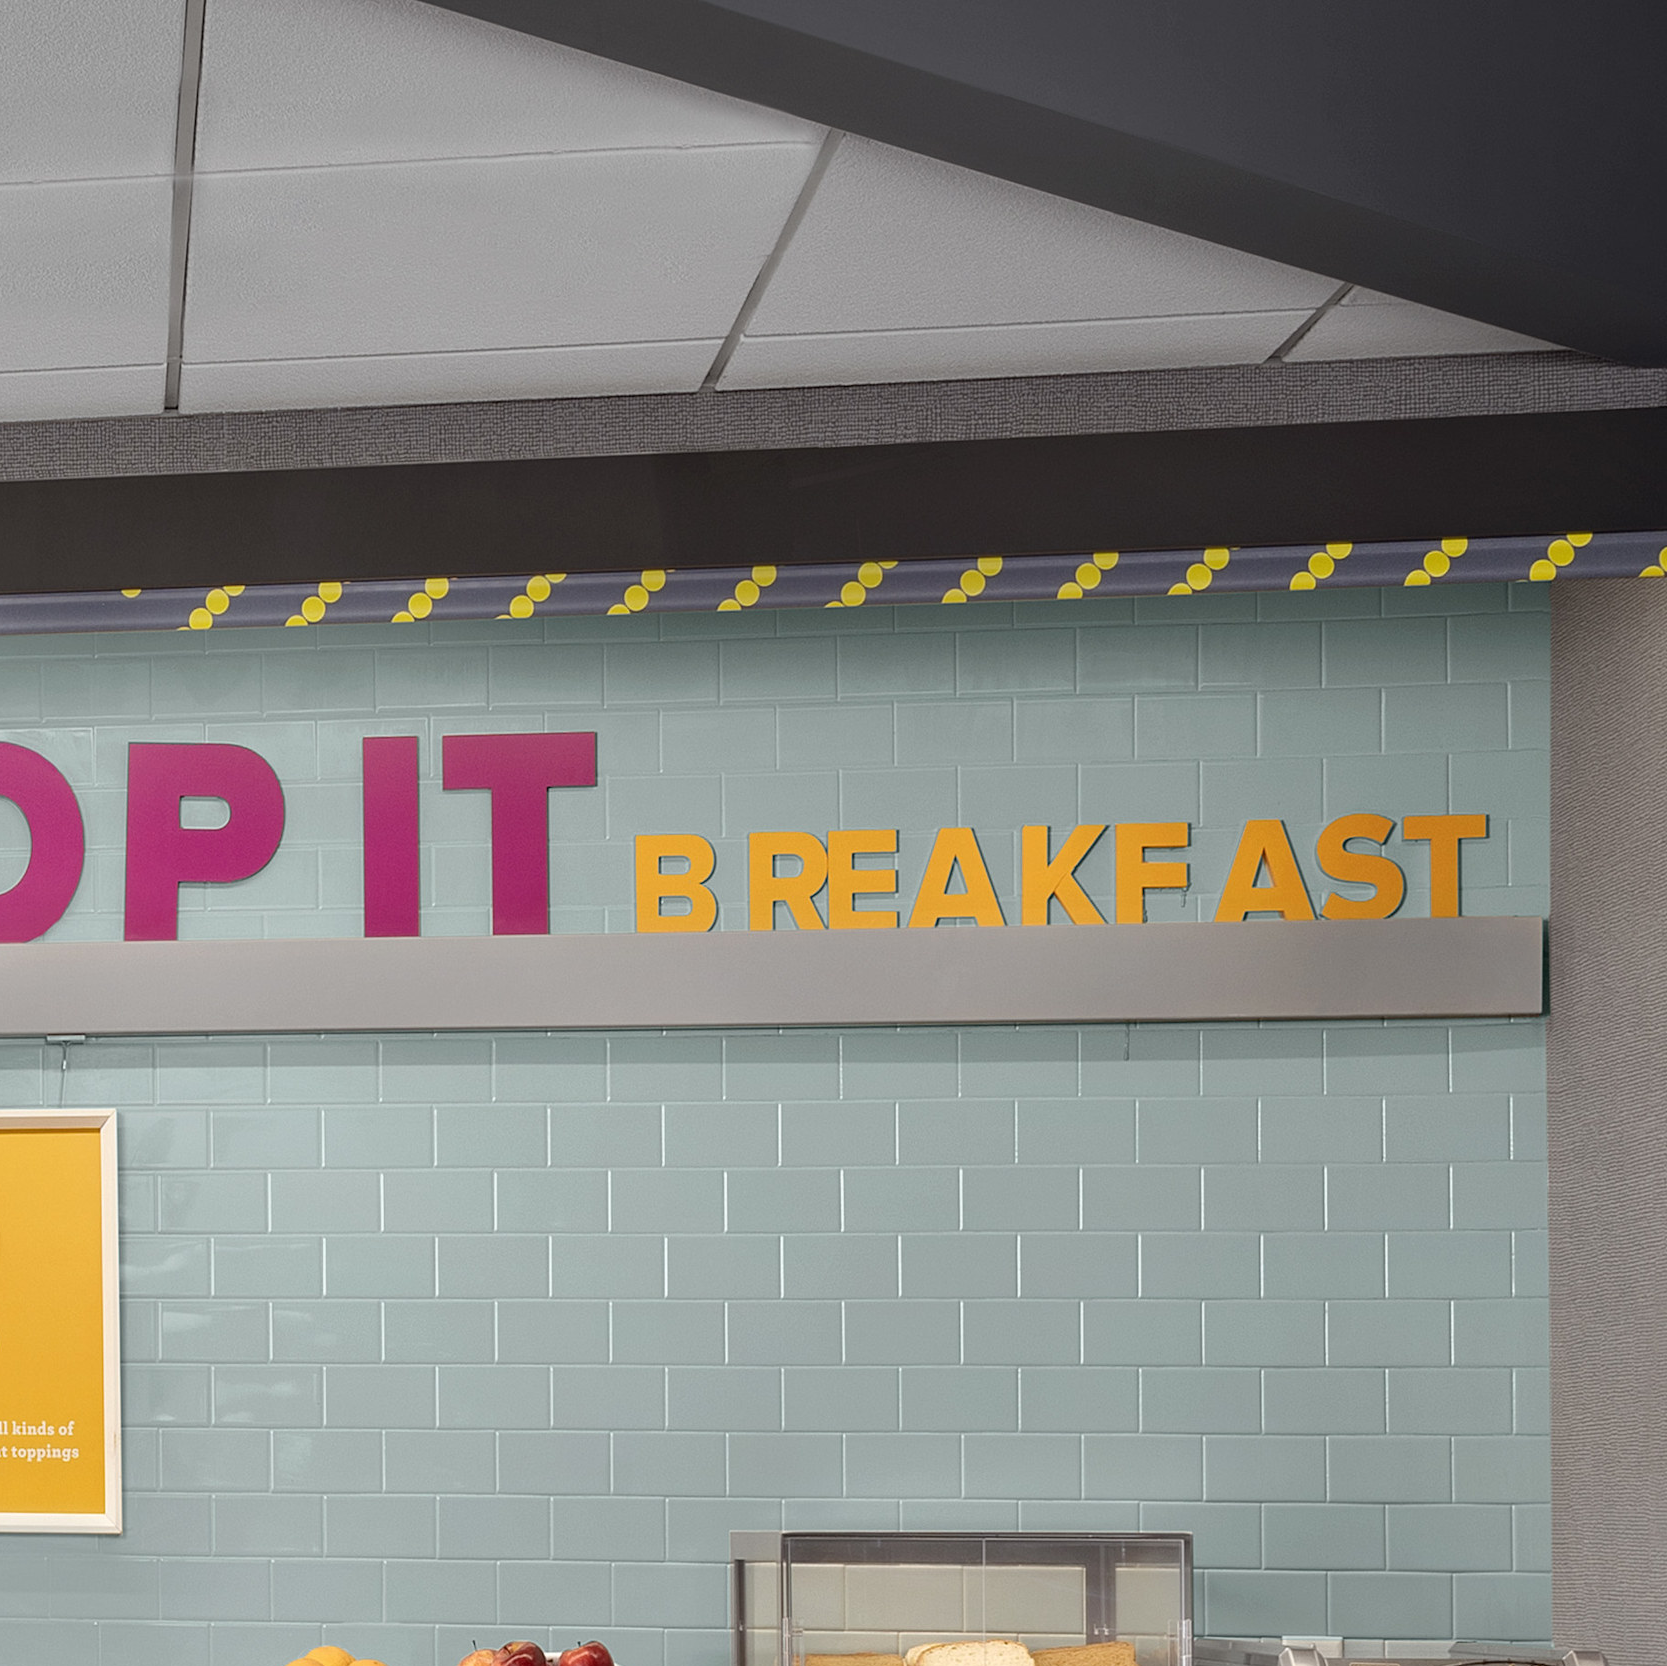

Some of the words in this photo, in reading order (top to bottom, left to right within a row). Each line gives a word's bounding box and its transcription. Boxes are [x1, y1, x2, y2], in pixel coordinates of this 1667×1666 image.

[362, 731, 598, 938] IT
[634, 813, 1489, 934] BREAKFAST
[11, 1444, 79, 1461] toppings
[12, 1420, 55, 1436] kinds
[57, 1420, 75, 1436] of
